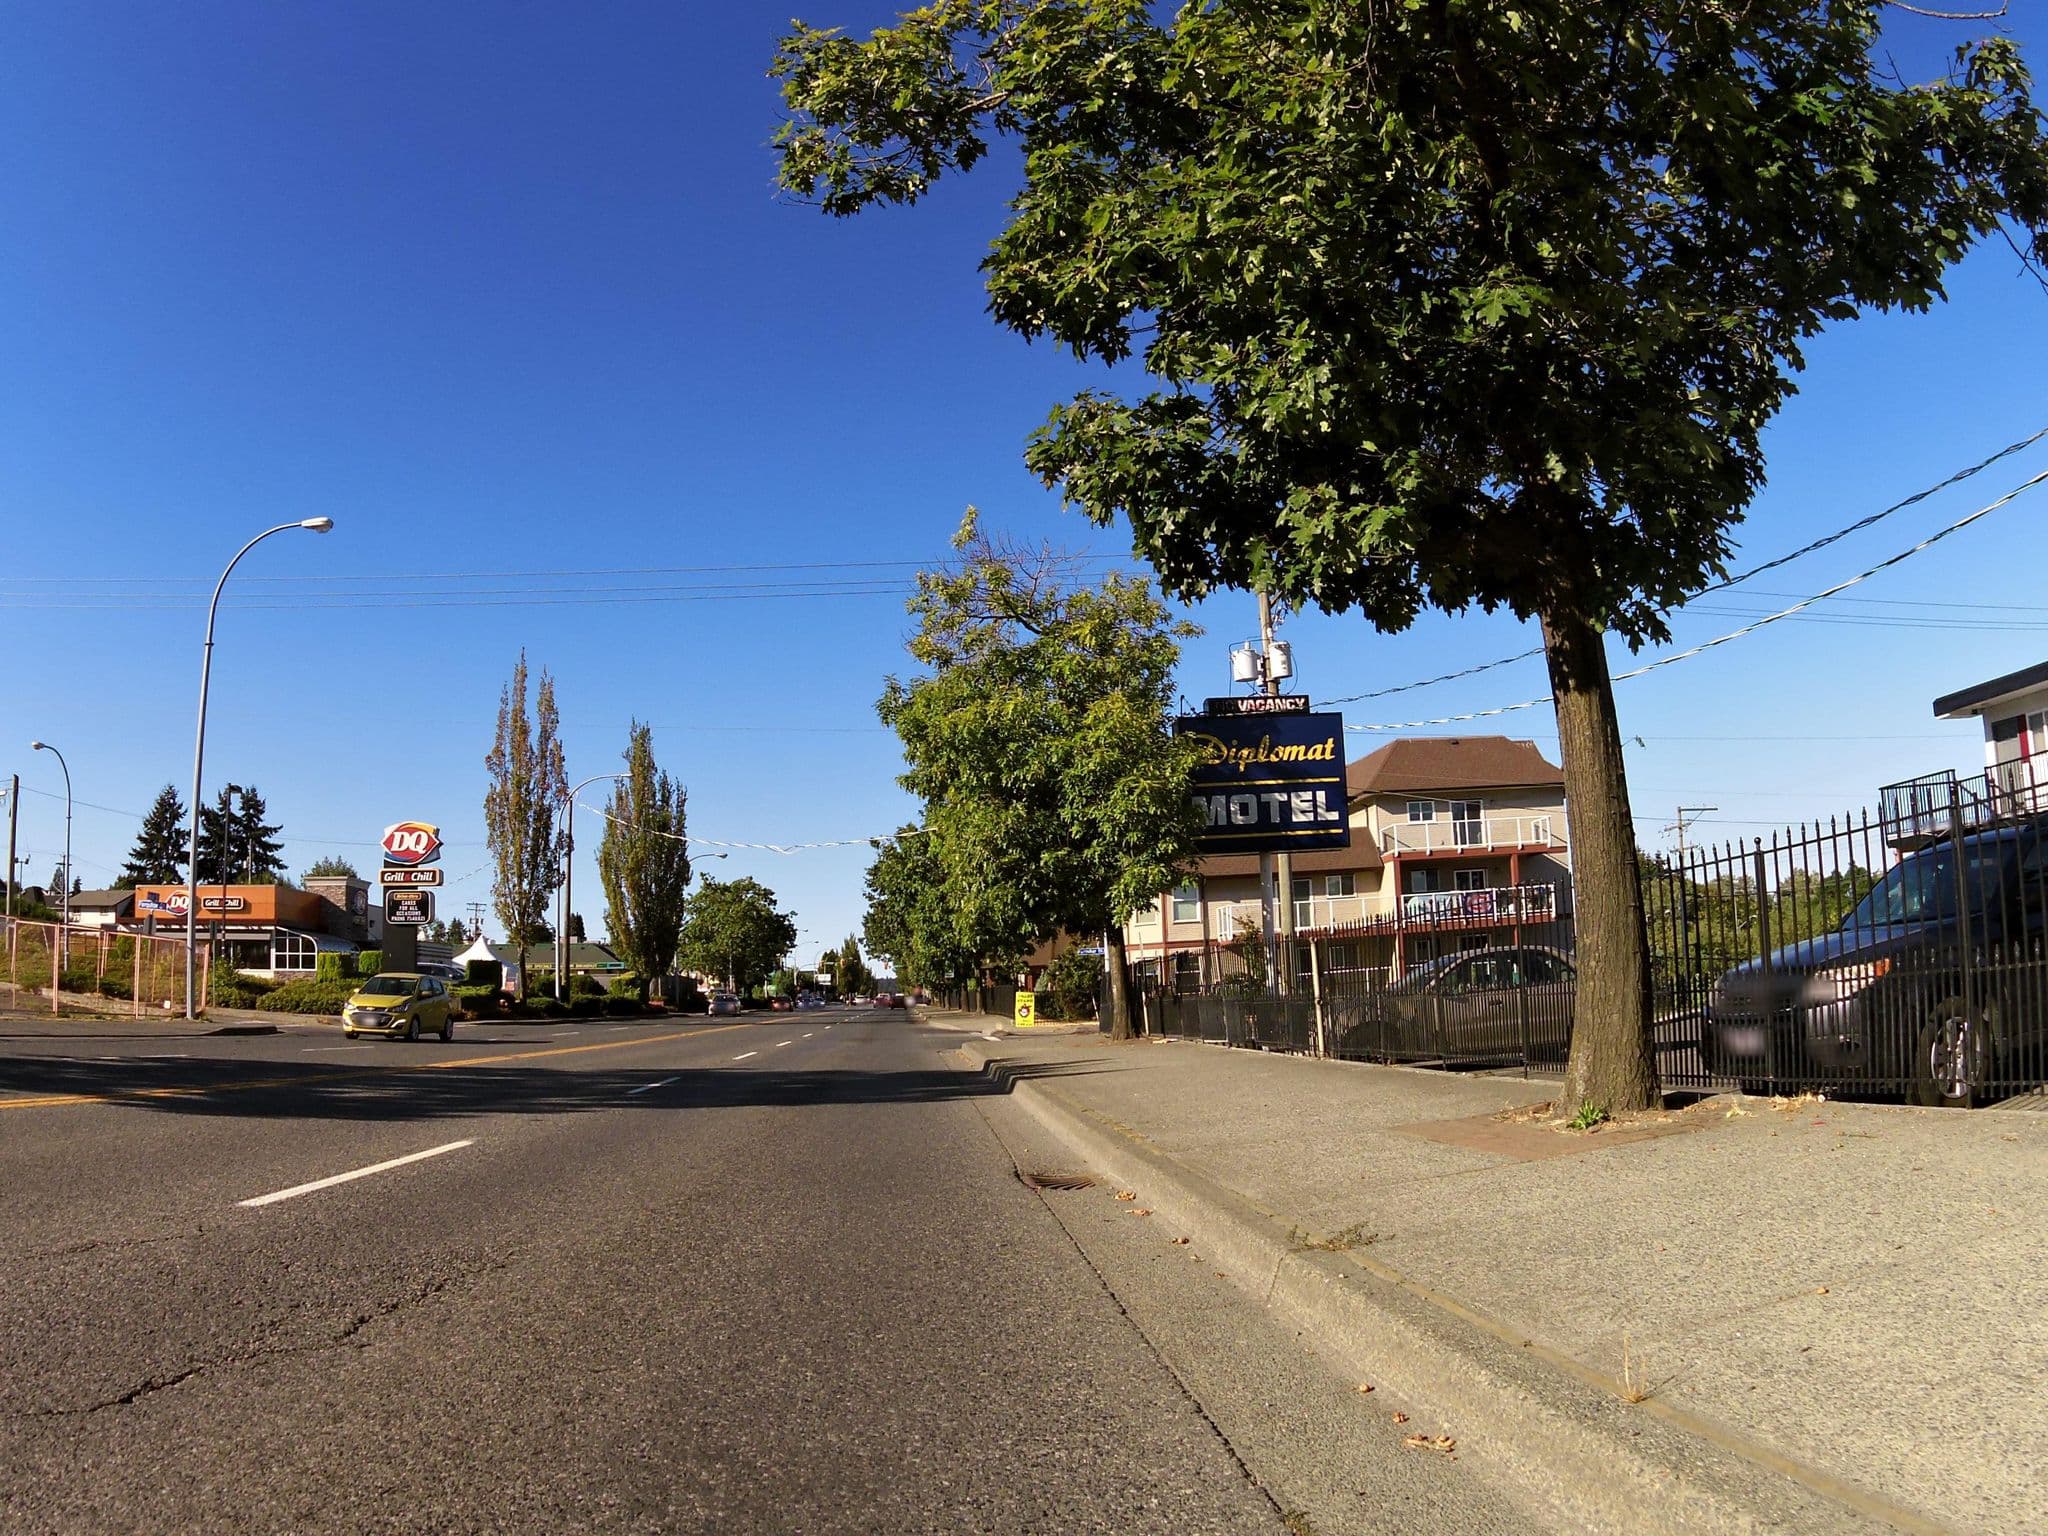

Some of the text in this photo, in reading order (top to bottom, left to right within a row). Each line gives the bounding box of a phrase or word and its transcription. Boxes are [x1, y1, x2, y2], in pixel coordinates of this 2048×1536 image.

[1237, 698, 1305, 711] VACANCY
[1195, 733, 1335, 772] Diplomat
[1191, 790, 1339, 826] MOTEL
[390, 831, 429, 854] DQ
[384, 872, 404, 882] Grill
[411, 872, 433, 881] Chill
[171, 896, 189, 909] DQ
[205, 899, 220, 907] Grill
